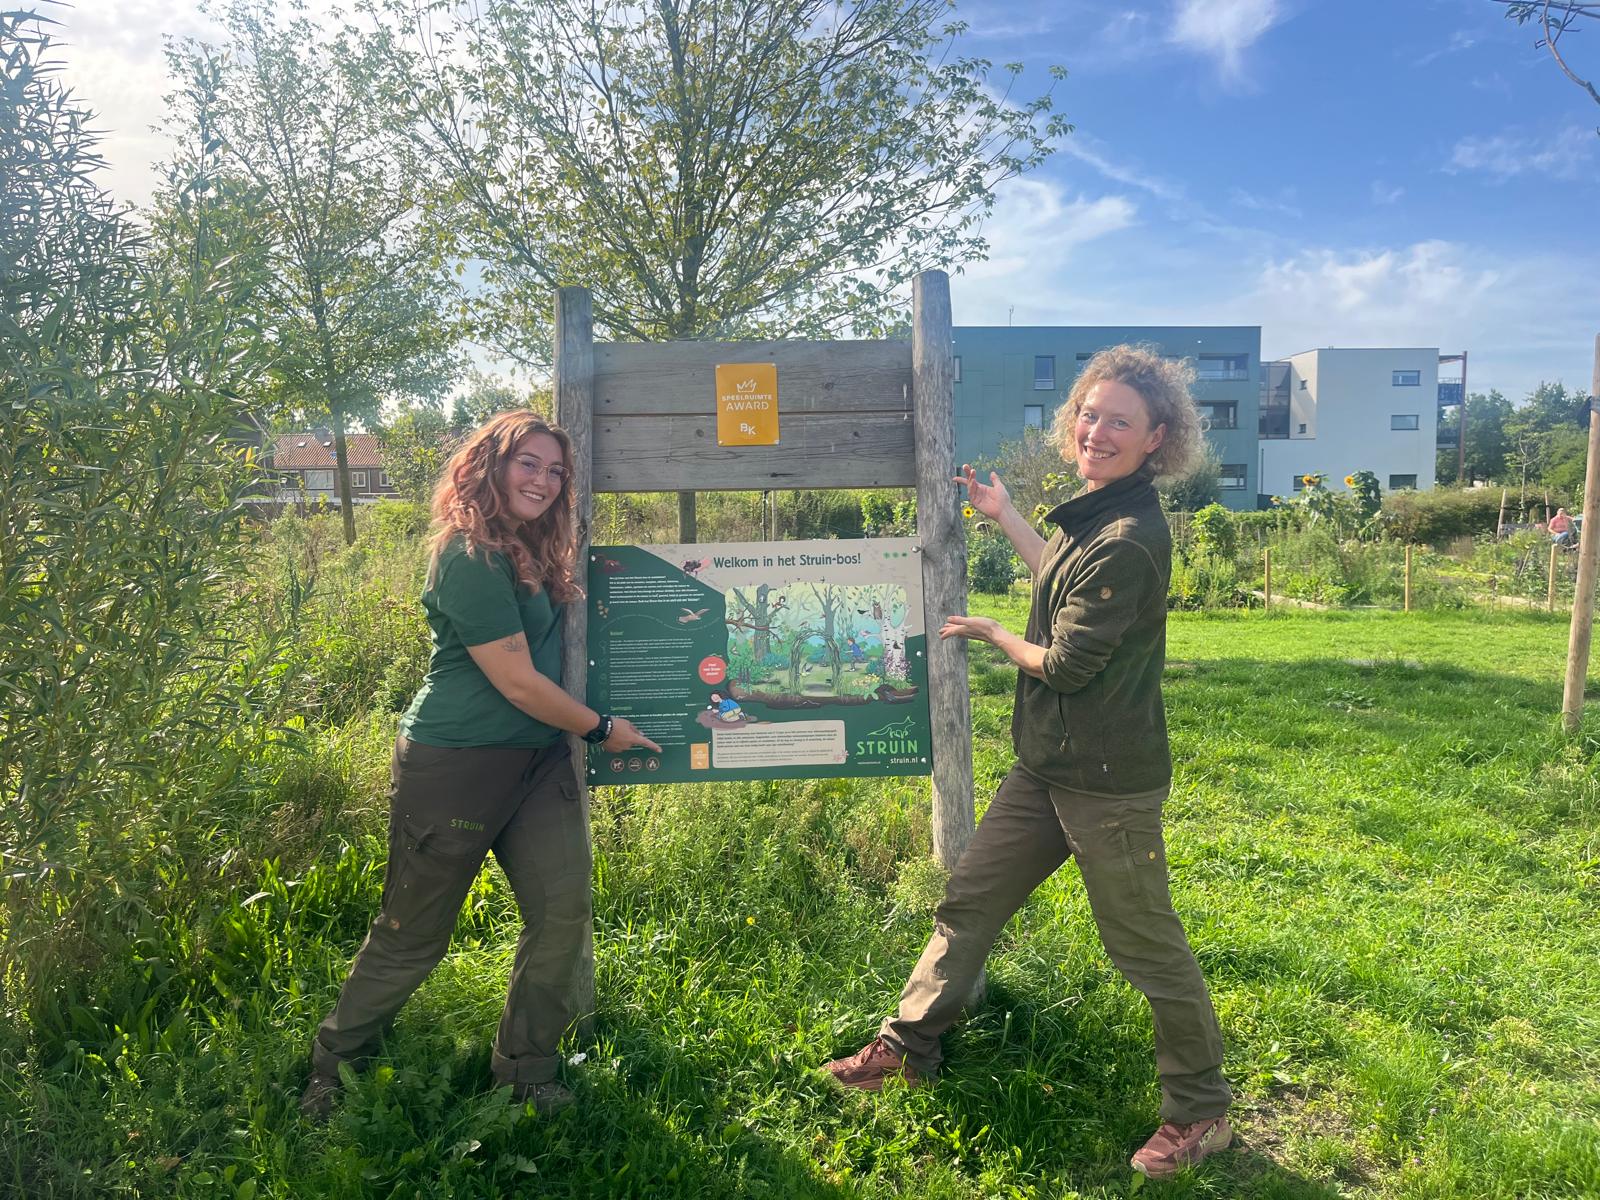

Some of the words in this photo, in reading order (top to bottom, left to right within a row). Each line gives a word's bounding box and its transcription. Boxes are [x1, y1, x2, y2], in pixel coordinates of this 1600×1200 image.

[726, 401, 769, 411] AWARD
[713, 556, 758, 568] Welkom
[763, 556, 774, 566] in
[777, 554, 796, 566] het
[800, 553, 862, 566] Struin-bos!
[856, 740, 918, 756] STRUIN
[450, 818, 485, 832] STRUIN
